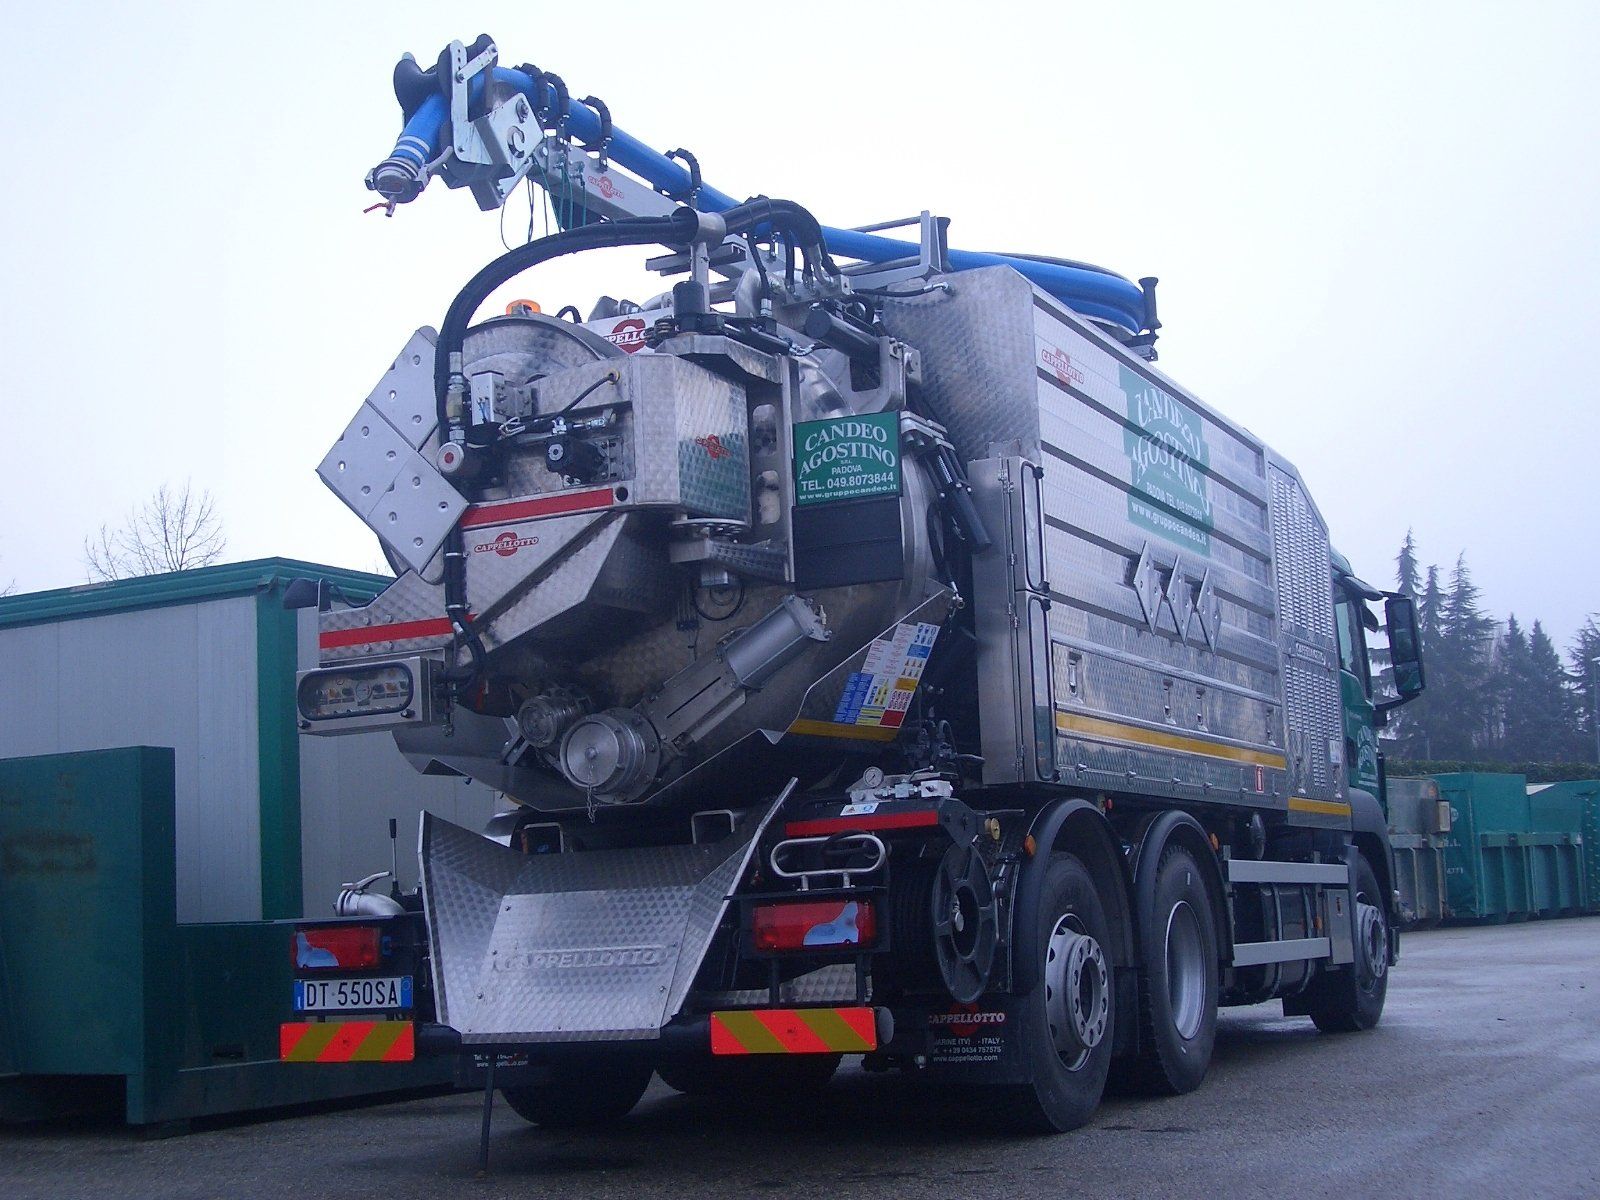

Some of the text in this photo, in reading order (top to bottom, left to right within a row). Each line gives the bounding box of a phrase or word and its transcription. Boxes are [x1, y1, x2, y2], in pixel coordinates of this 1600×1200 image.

[805, 422, 887, 451] CANDEO
[799, 442, 896, 480] AGOSTINO
[831, 465, 862, 475] PADOVA
[801, 471, 894, 491] TEL. 049.8073844
[799, 484, 897, 500] www.gruppocandeo.it
[475, 537, 539, 552] CAPPELLOTTO
[306, 983, 329, 1007] DT
[338, 980, 398, 1006] 550SA
[981, 1037, 1000, 1045] ITALY
